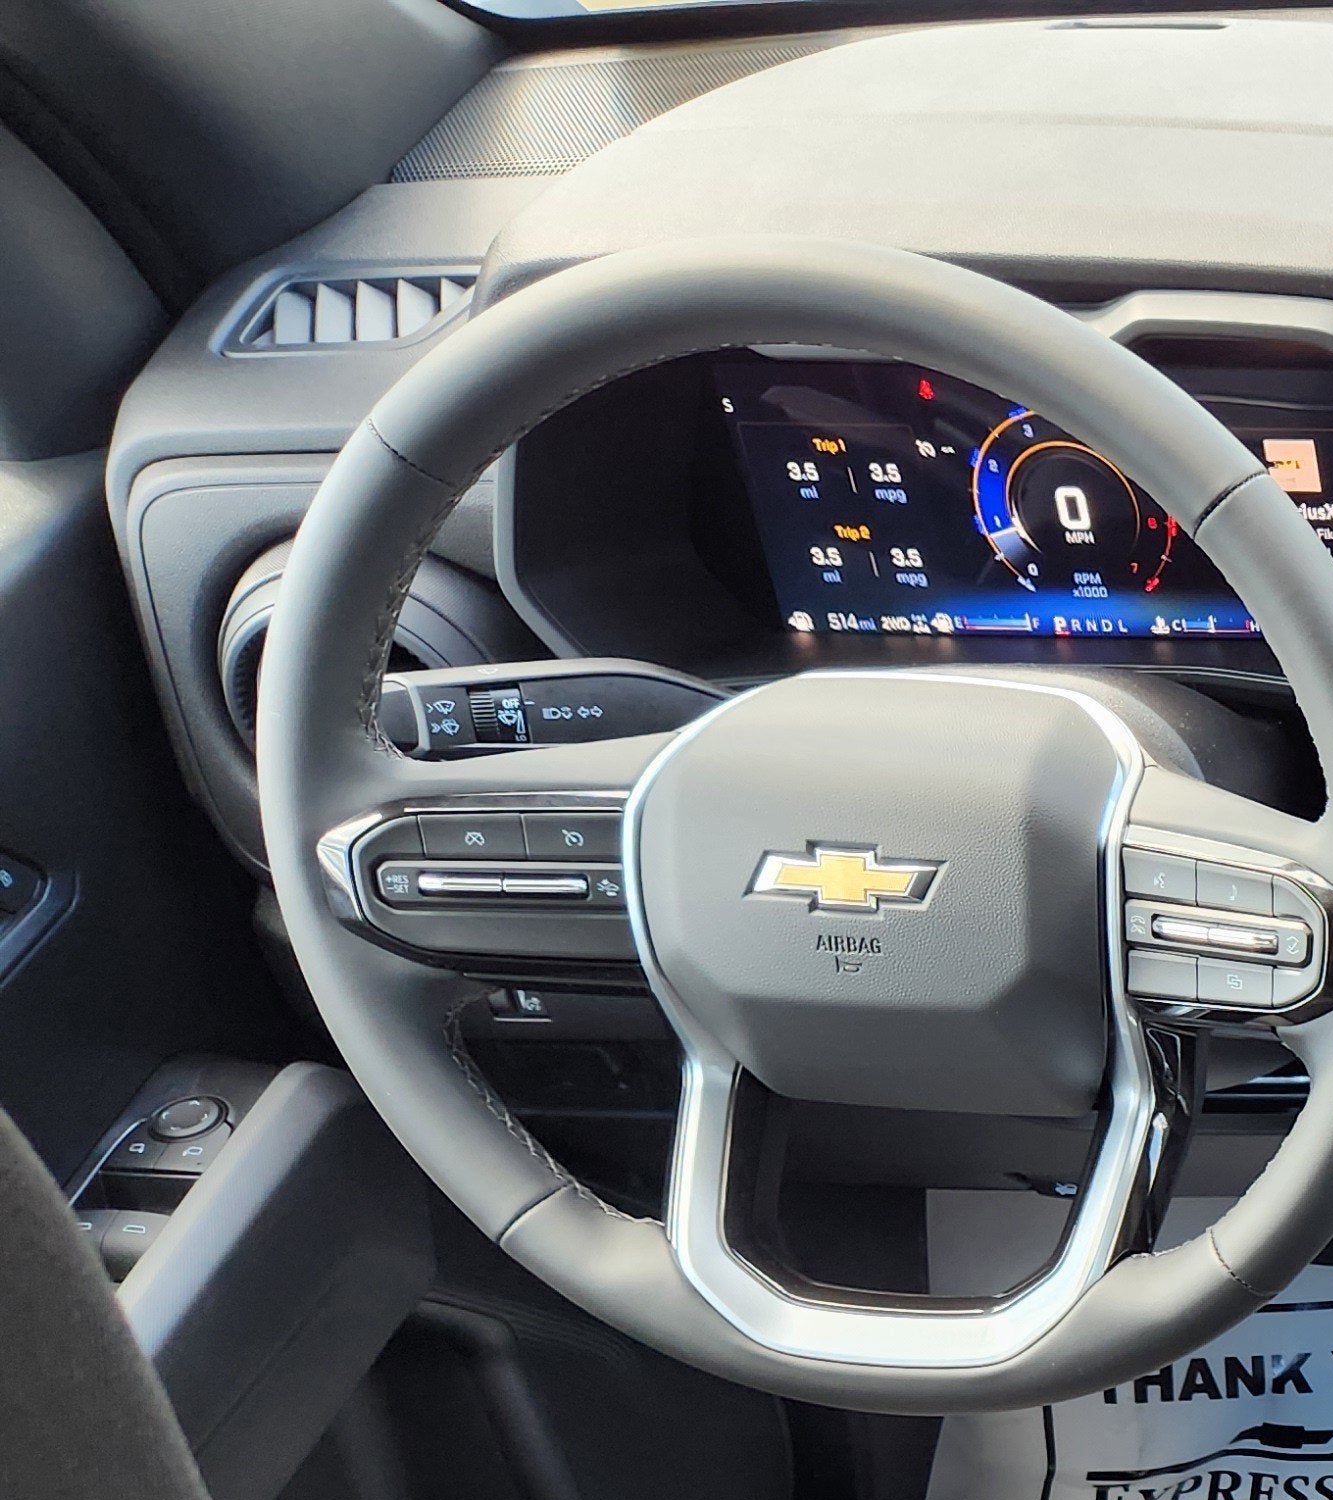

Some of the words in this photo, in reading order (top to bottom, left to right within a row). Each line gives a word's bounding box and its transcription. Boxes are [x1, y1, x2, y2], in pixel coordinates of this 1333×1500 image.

[721, 397, 734, 413] S
[812, 437, 838, 455] Trip
[839, 438, 847, 453] 1
[786, 461, 820, 482] 3.5
[868, 462, 902, 484] 3.5
[874, 488, 907, 505] mpg
[1055, 486, 1092, 530] 0
[833, 525, 858, 541] Trip
[1065, 531, 1095, 545] MPH
[810, 546, 844, 567] 3.5
[890, 547, 924, 569] 3.5
[895, 571, 929, 588] mpg
[1073, 572, 1102, 585] RPM
[1053, 616, 1068, 632] P
[1071, 618, 1082, 632] R
[1086, 618, 1098, 632] N
[1101, 619, 1113, 632] D
[1118, 619, 1128, 633] L
[501, 697, 520, 709] OFF
[816, 934, 882, 954] AIRBAG
[1104, 1351, 1312, 1405] HANK
